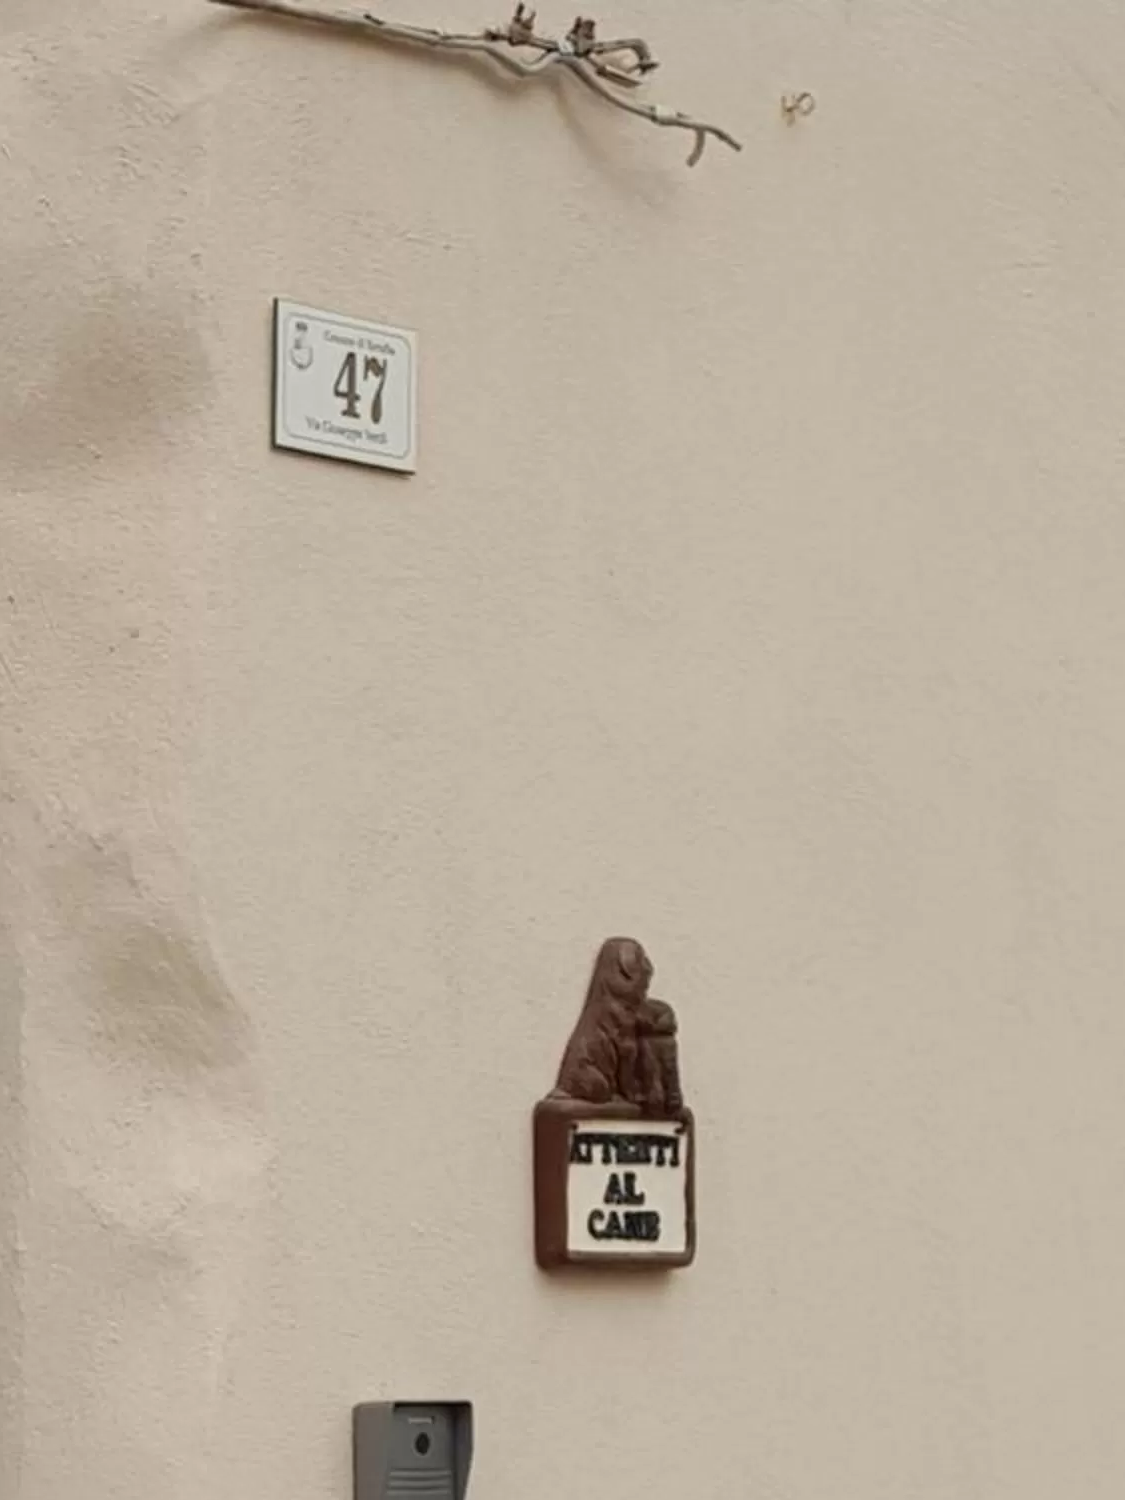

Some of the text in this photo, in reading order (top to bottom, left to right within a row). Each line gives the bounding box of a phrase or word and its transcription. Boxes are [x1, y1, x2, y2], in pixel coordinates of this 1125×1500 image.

[333, 351, 388, 425] 47
[569, 1132, 680, 1167] ATTENTI
[603, 1171, 645, 1205] AL
[586, 1208, 661, 1242] CANE
